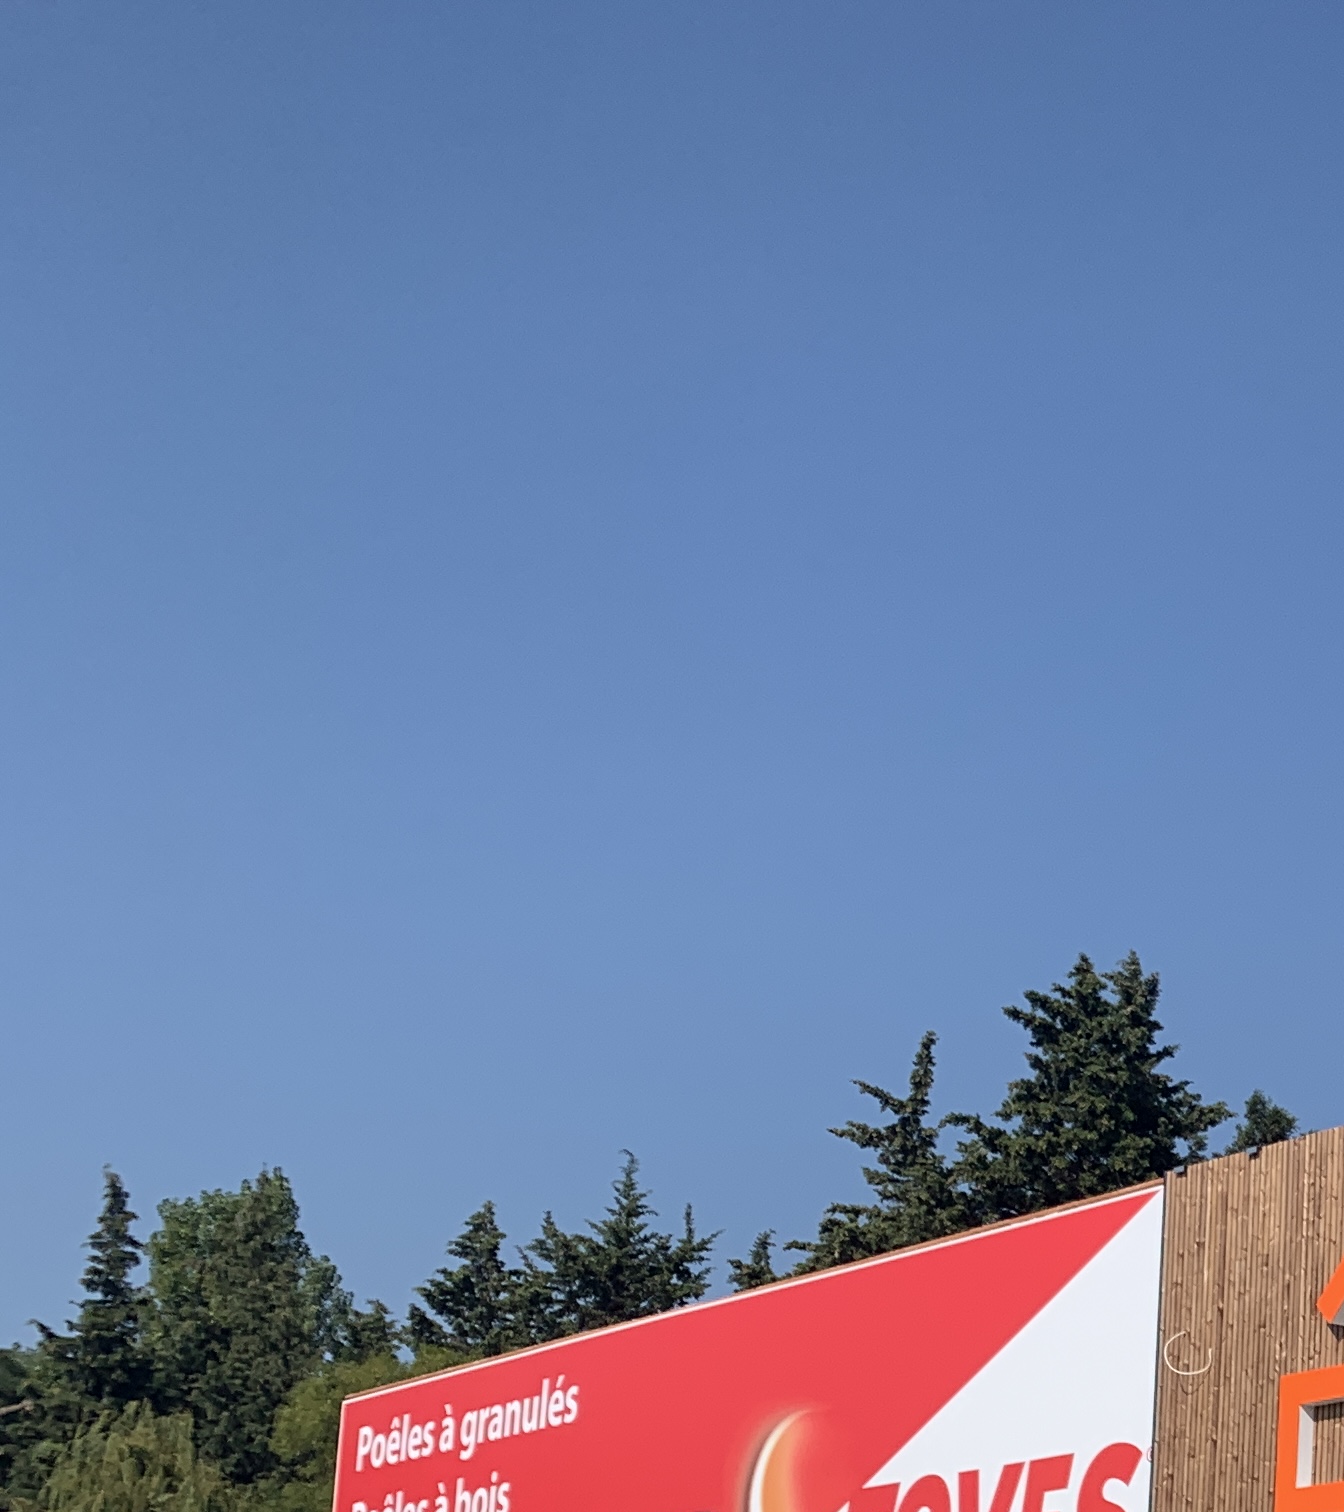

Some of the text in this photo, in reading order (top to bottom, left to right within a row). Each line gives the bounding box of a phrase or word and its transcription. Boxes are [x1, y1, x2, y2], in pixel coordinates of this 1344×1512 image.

[355, 1374, 580, 1472] Poêles à granulés
